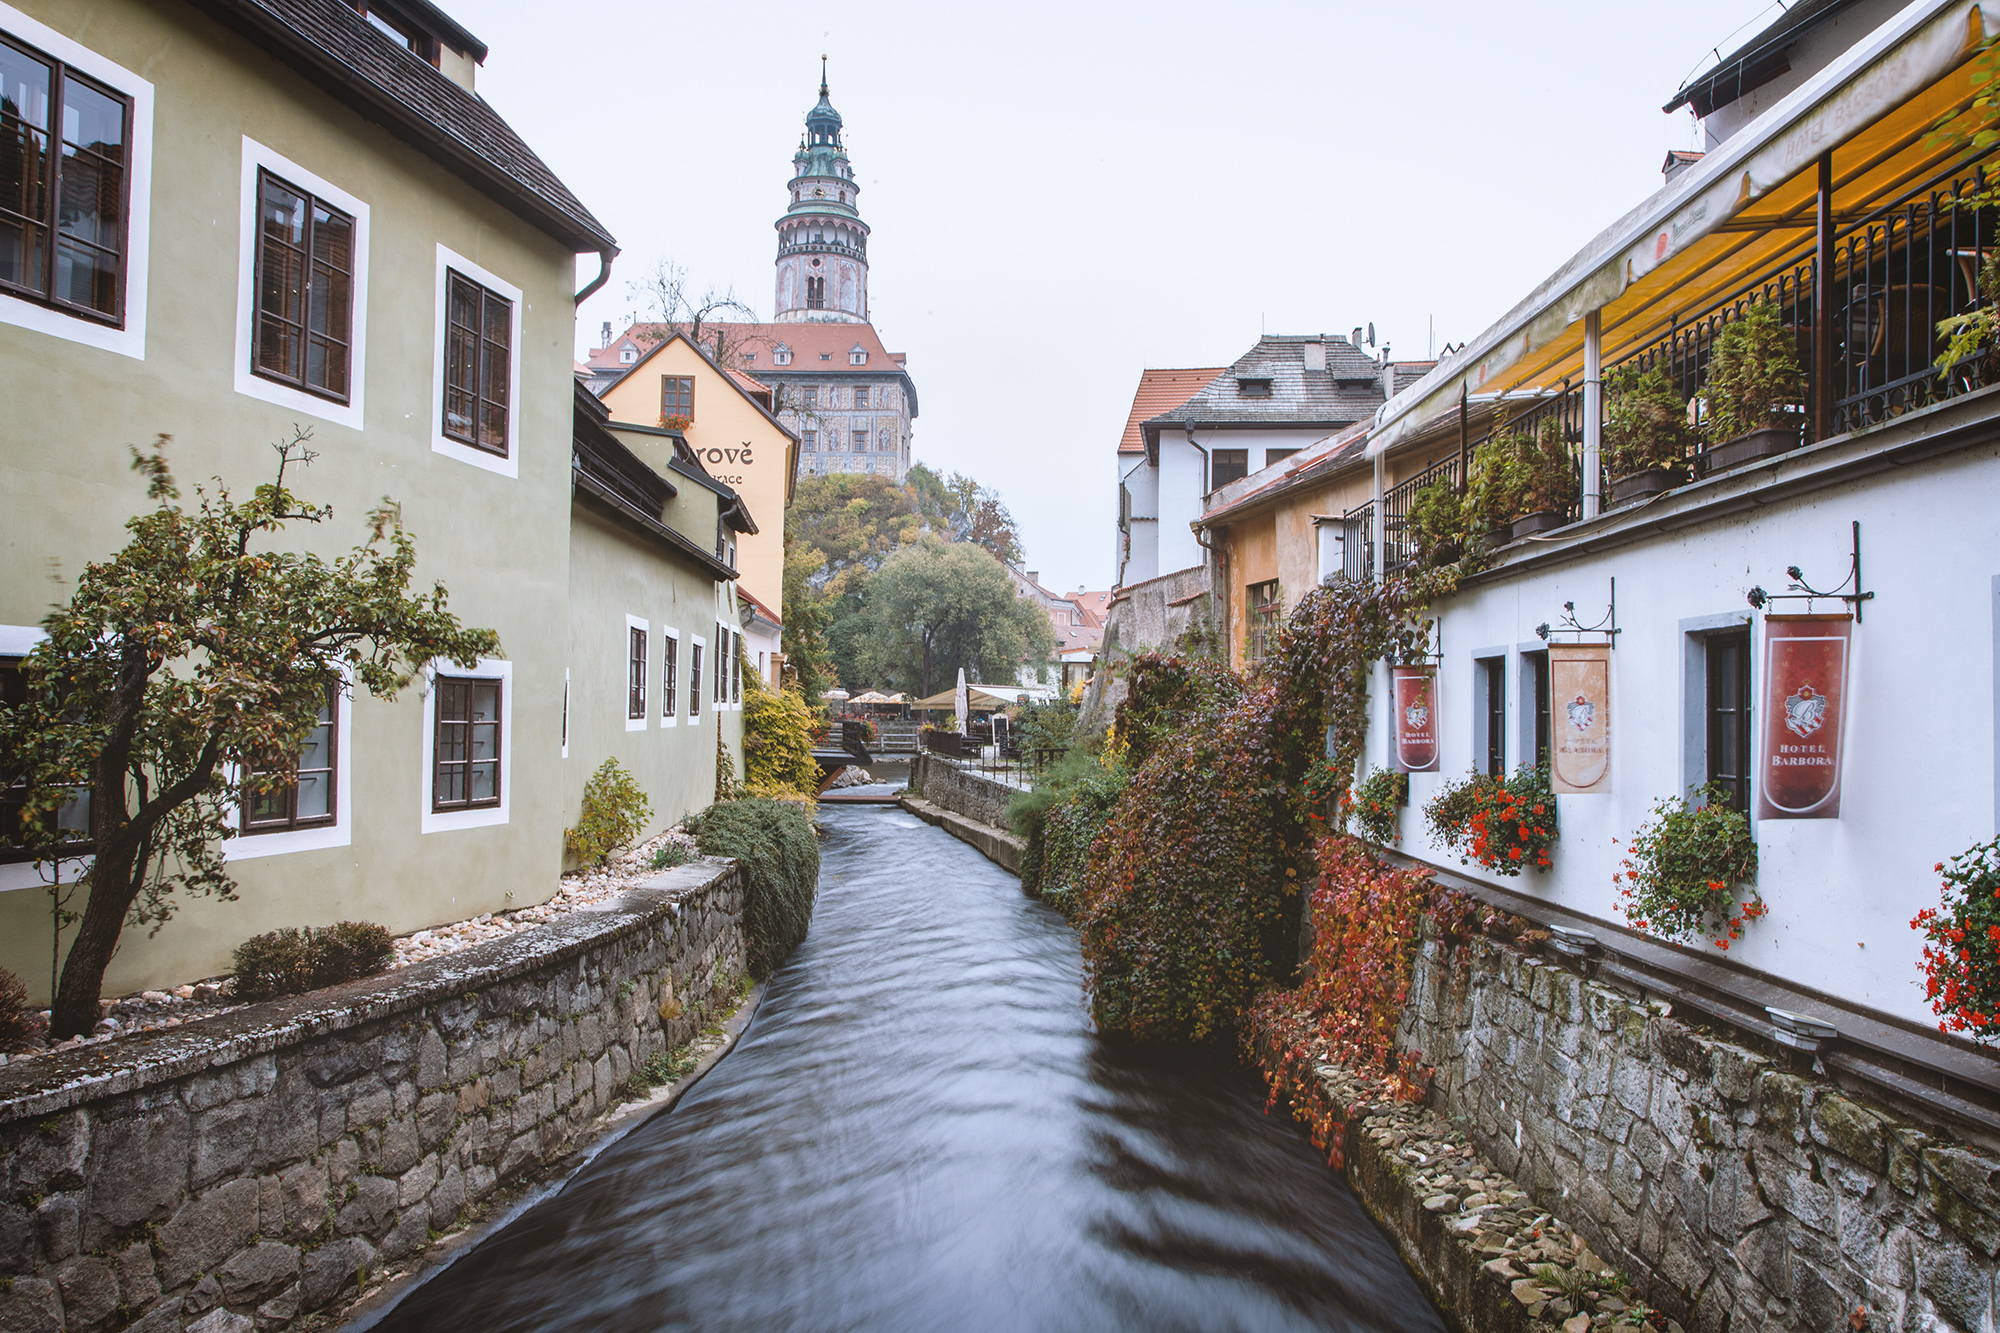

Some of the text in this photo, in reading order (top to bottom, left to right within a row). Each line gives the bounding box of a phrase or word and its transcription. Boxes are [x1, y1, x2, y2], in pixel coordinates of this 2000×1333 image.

[696, 441, 753, 465] rově
[1780, 744, 1825, 753] HOTEL
[1772, 755, 1832, 766] BARBORA
